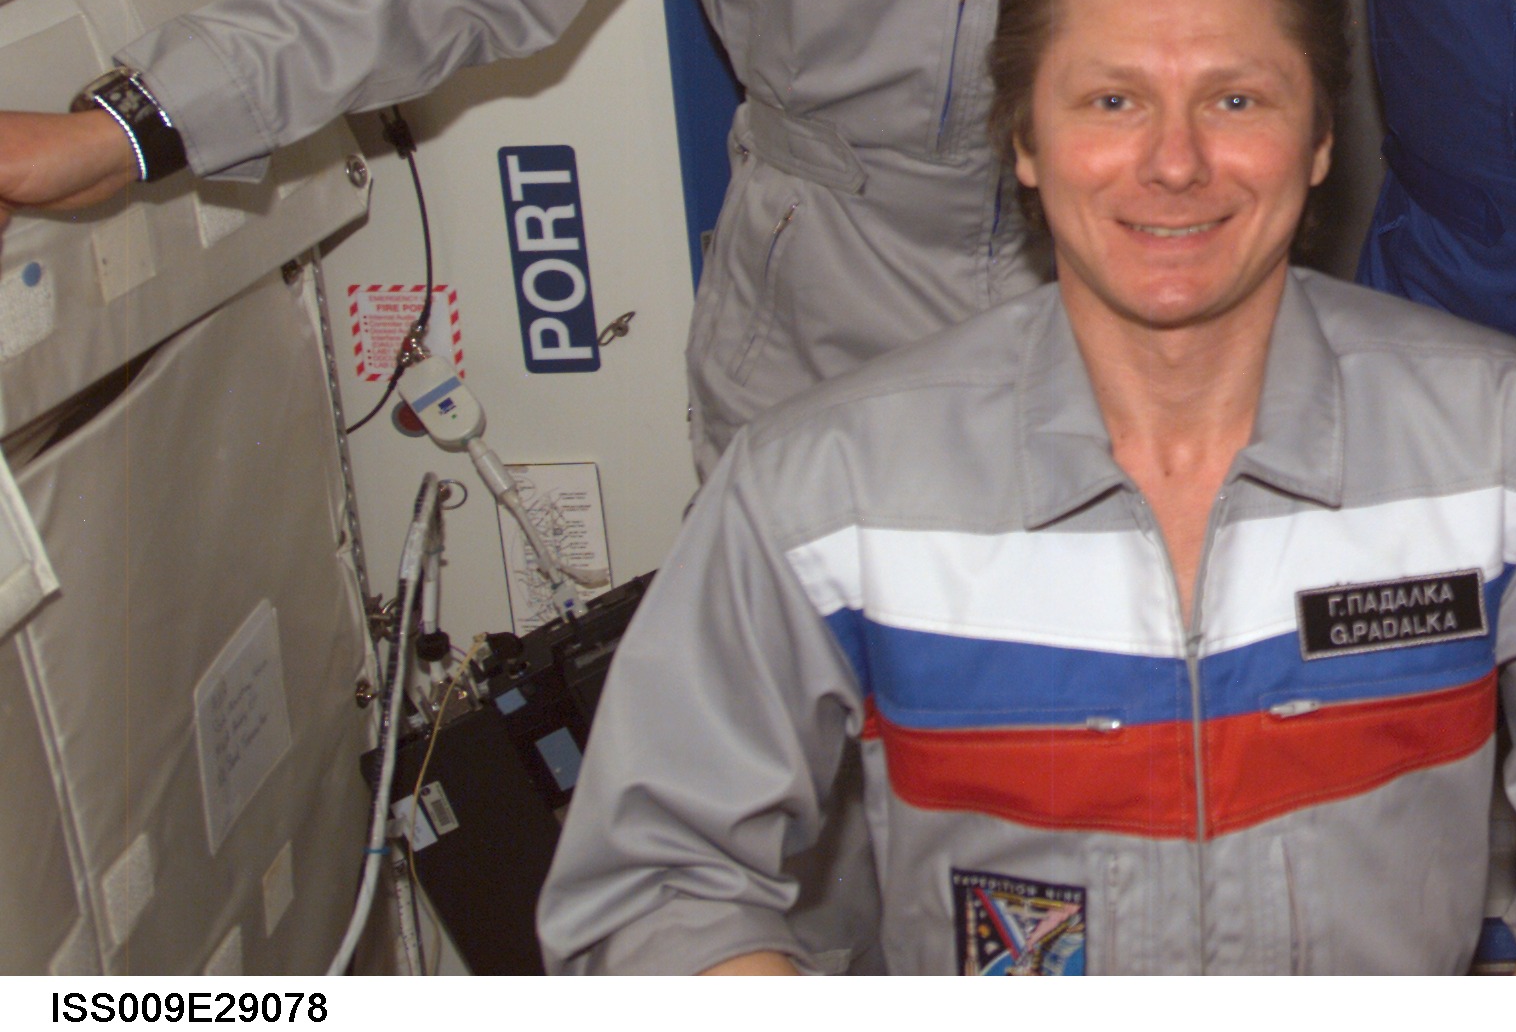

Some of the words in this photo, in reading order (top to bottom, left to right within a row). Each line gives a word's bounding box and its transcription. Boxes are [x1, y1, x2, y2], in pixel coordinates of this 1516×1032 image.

[506, 155, 594, 360] PORT
[376, 304, 399, 312] FIRE
[403, 304, 425, 312] POR
[1328, 582, 1454, 617] Г.ПАДАЛКА
[1330, 610, 1458, 645] G.PADALKA
